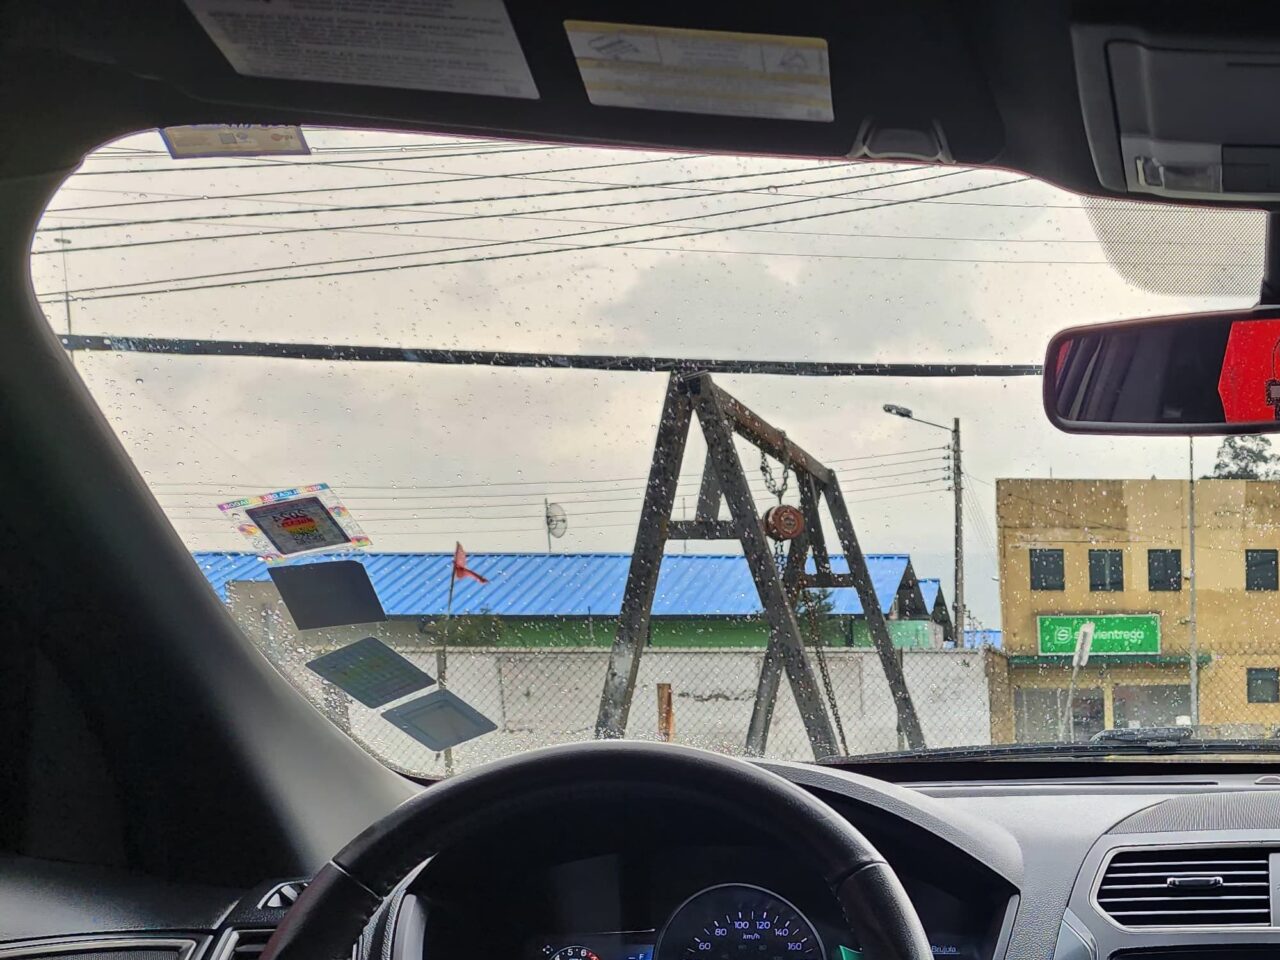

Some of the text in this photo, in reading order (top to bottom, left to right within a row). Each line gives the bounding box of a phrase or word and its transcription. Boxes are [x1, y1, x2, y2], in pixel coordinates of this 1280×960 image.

[1073, 629, 1145, 643] svientrega
[734, 921, 750, 929] 100
[756, 921, 771, 929] 120
[714, 928, 727, 936] 80
[774, 928, 789, 937] 140
[699, 942, 711, 950] 60
[788, 942, 803, 950] 160
[581, 949, 587, 957] 6
